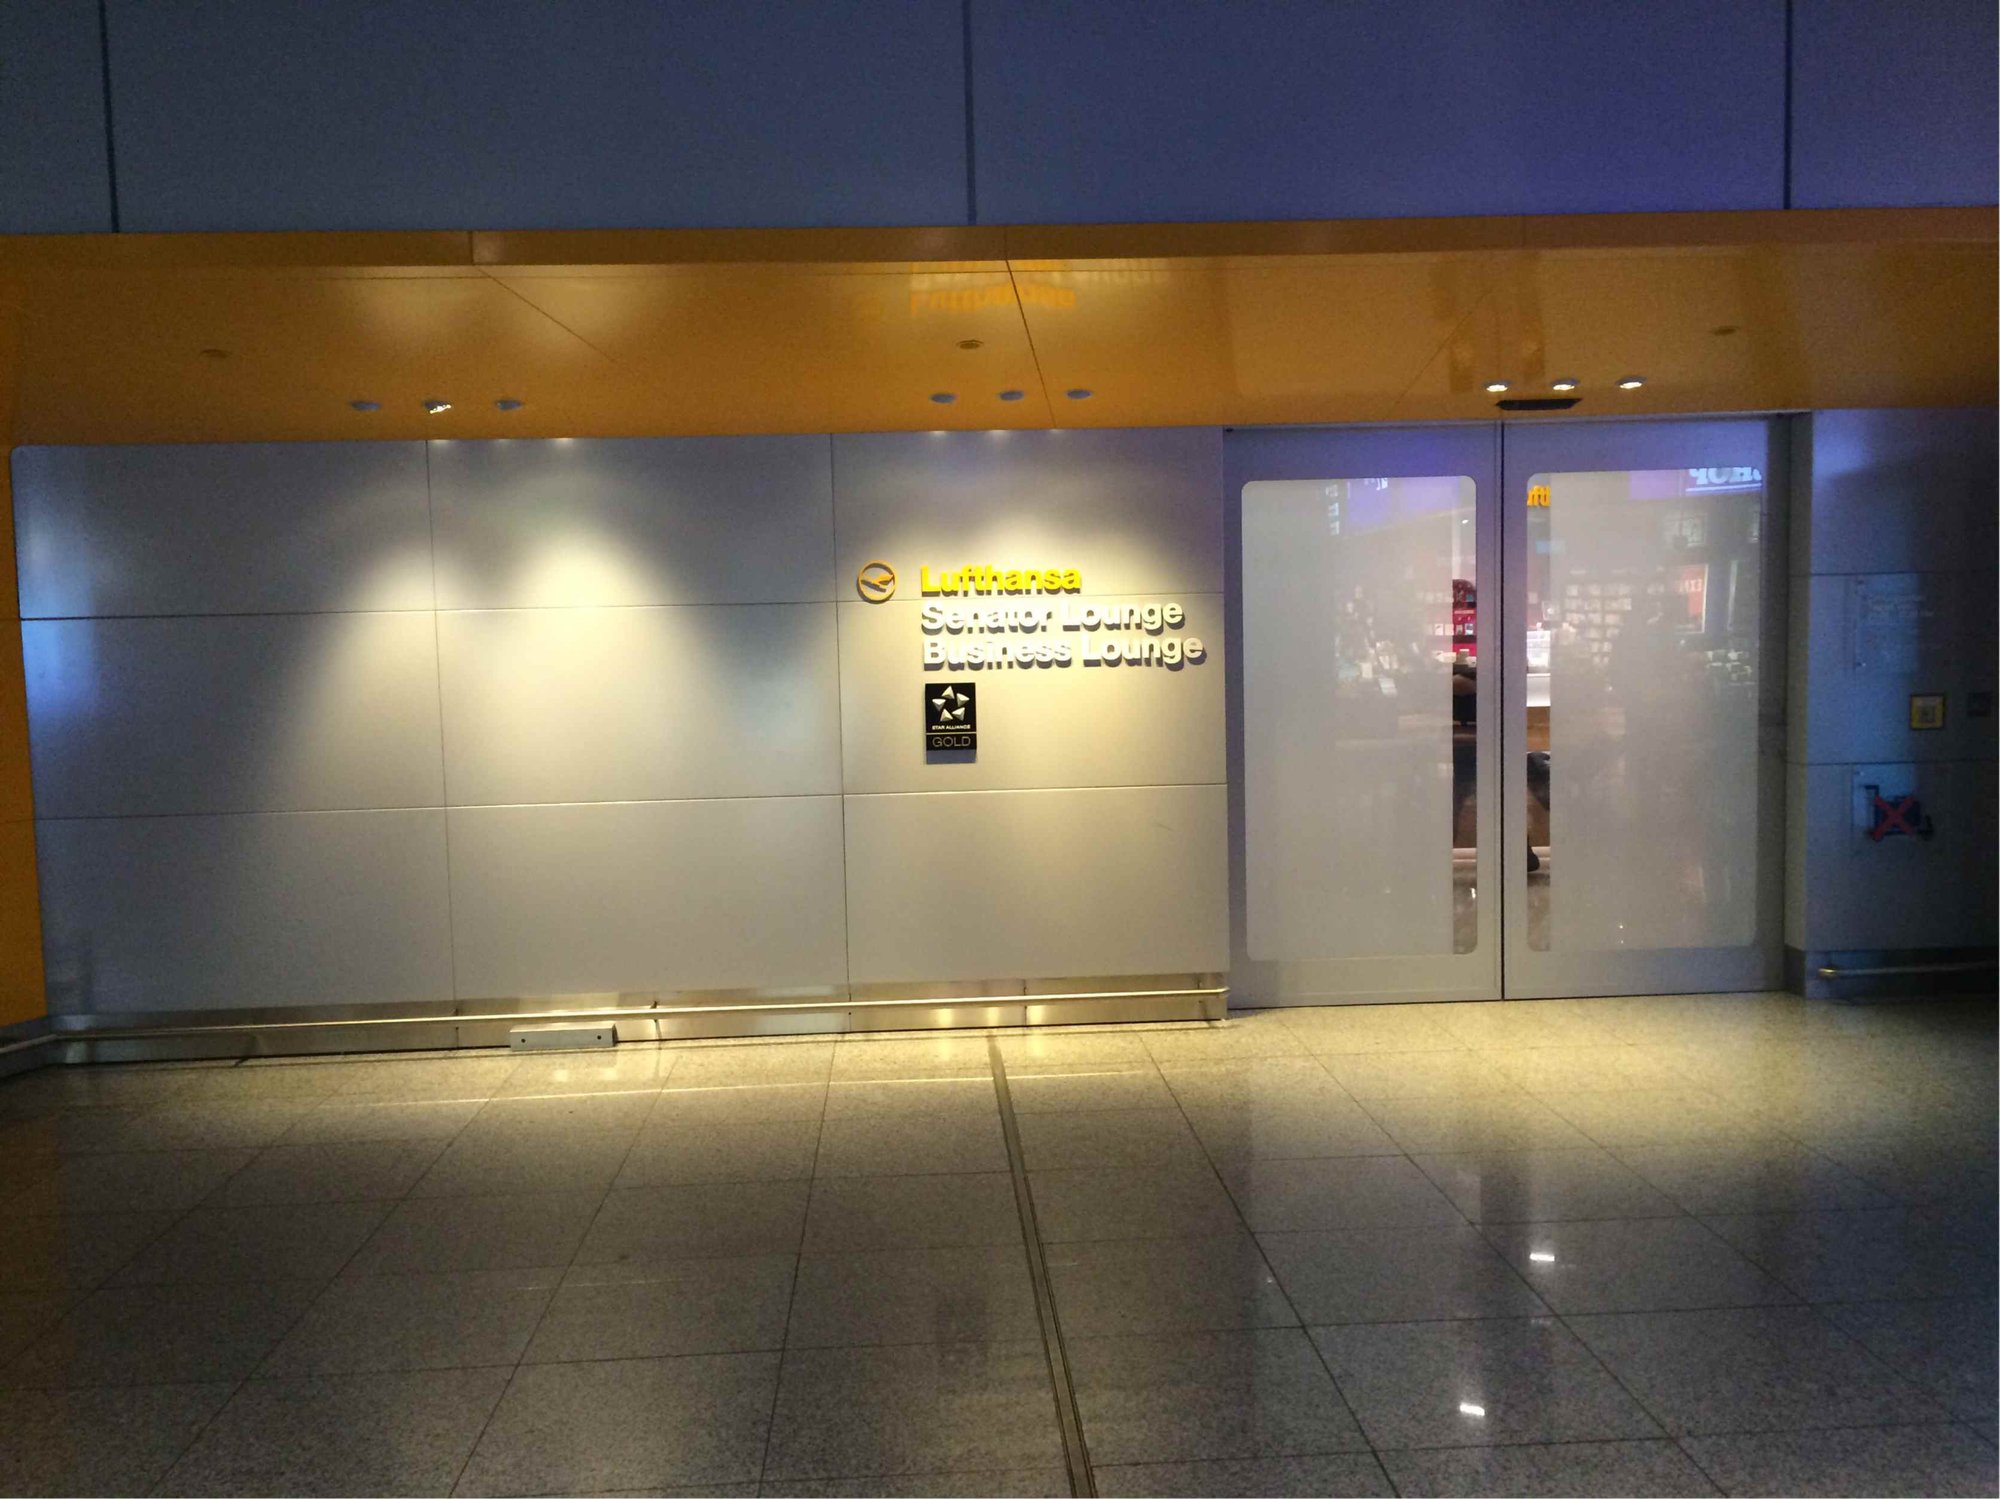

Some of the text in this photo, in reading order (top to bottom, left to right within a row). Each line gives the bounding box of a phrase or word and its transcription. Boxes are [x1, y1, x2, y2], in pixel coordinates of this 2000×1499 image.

[920, 564, 1081, 595] Lufthansa
[921, 600, 1184, 633] Senator Lounge
[923, 634, 1206, 668] Business Lounge
[931, 735, 972, 748] GOLD
